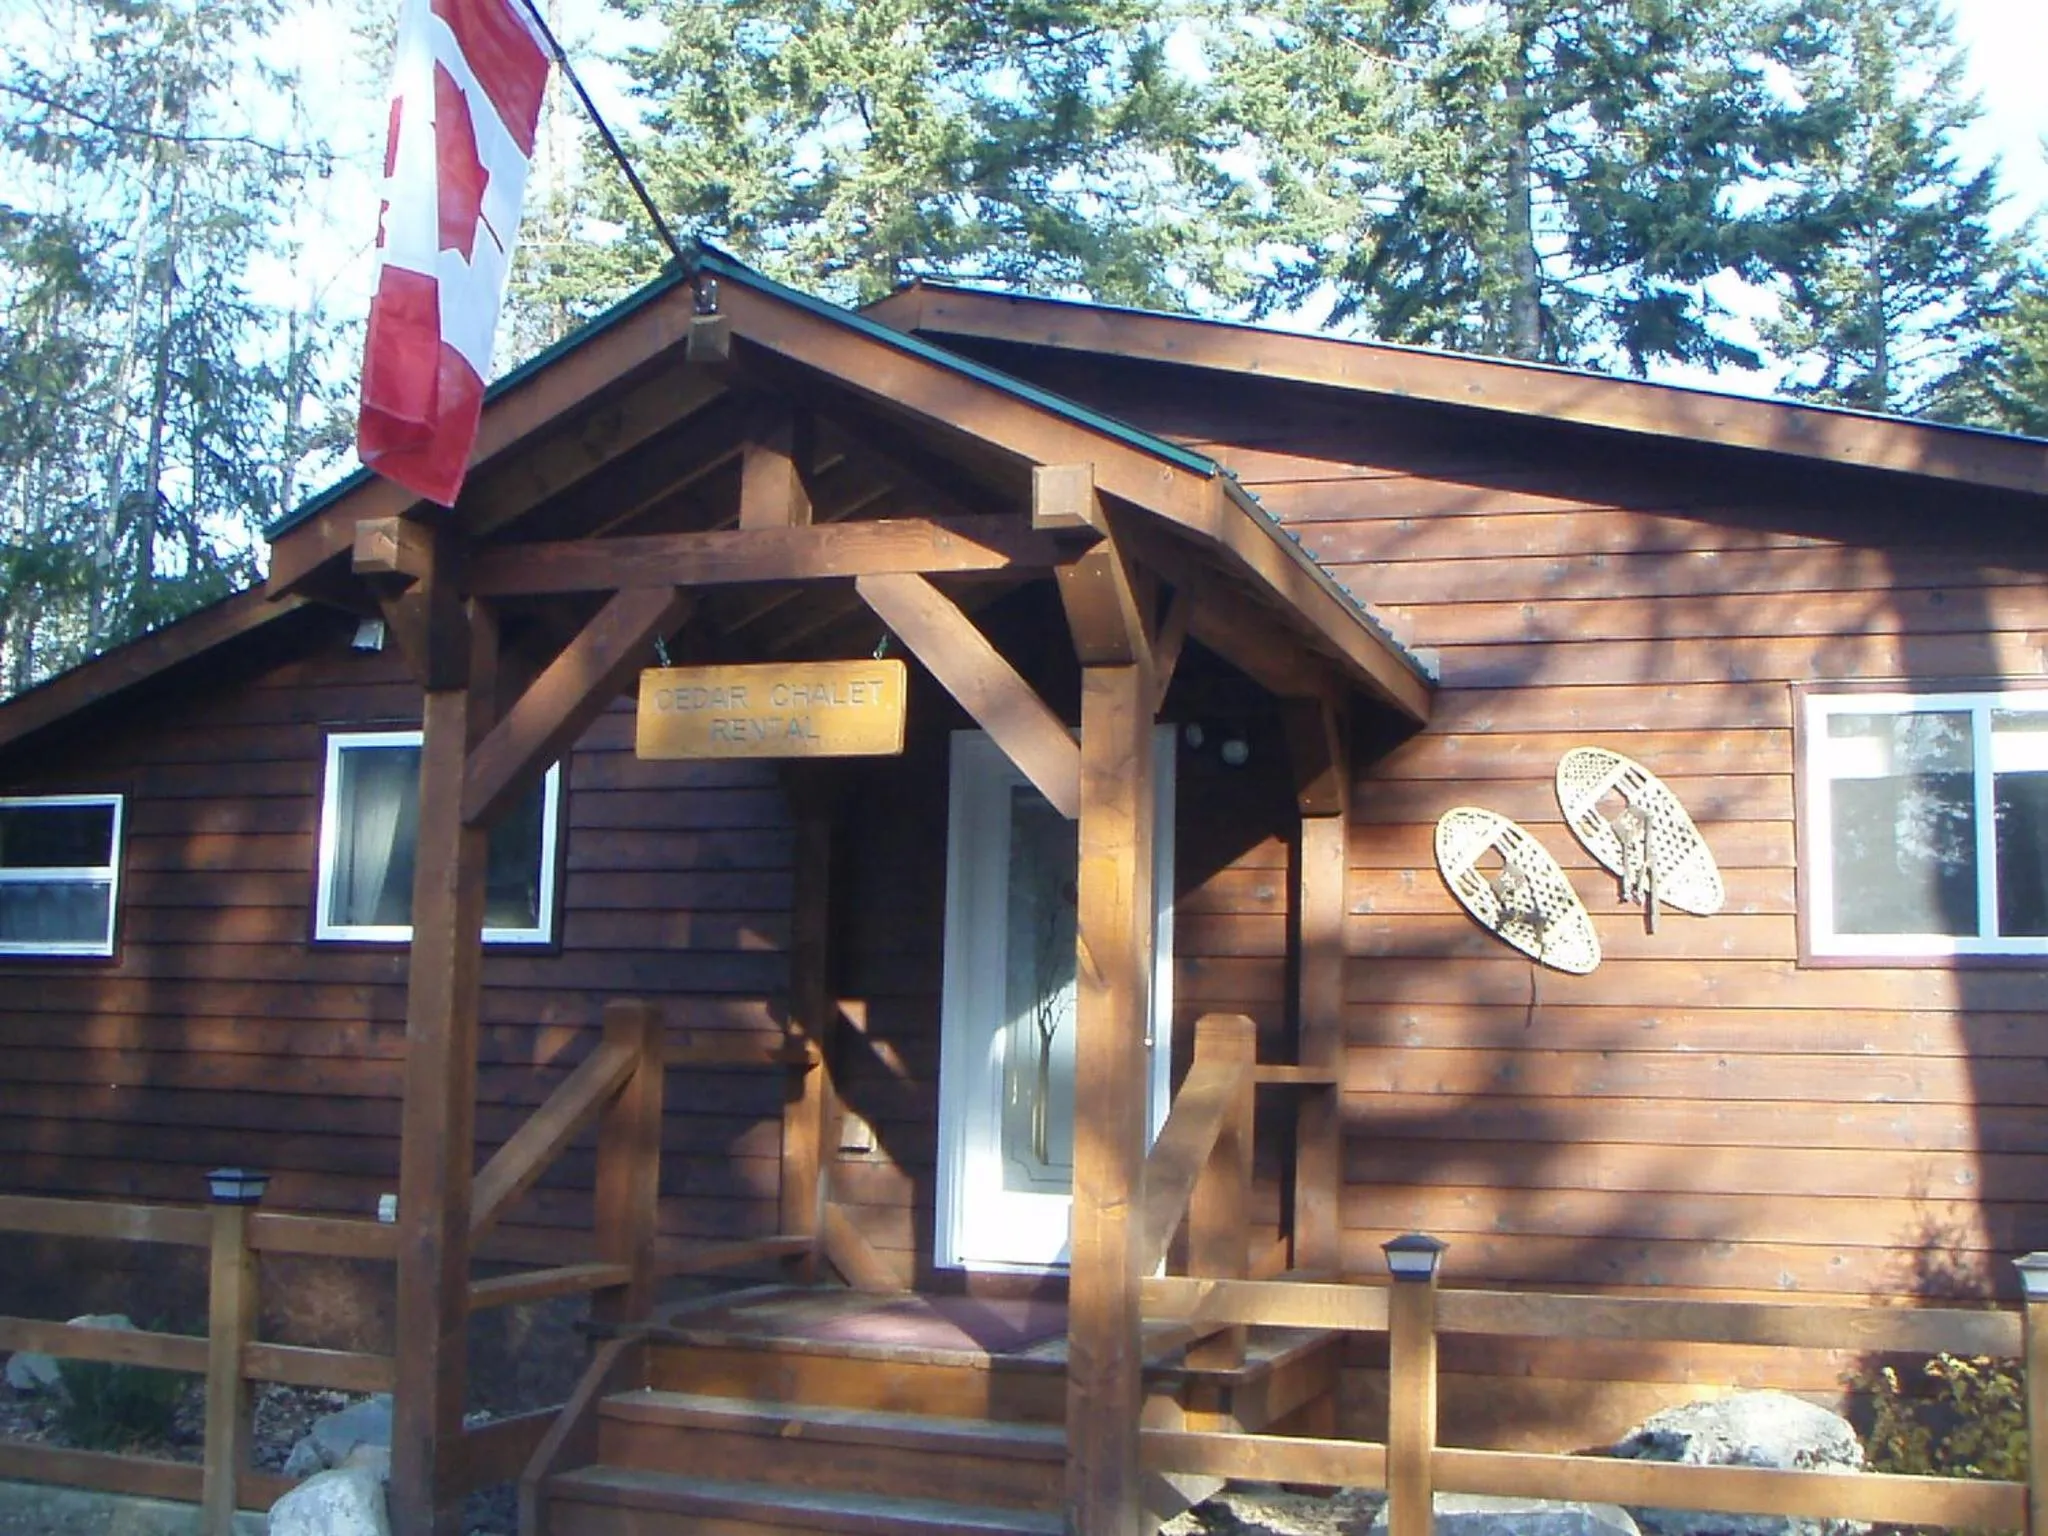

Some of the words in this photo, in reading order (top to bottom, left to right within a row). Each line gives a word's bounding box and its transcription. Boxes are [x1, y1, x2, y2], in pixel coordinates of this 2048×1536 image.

[655, 685, 748, 711] CEDAR
[770, 680, 884, 707] CHALET
[709, 717, 820, 742] RENTAL
